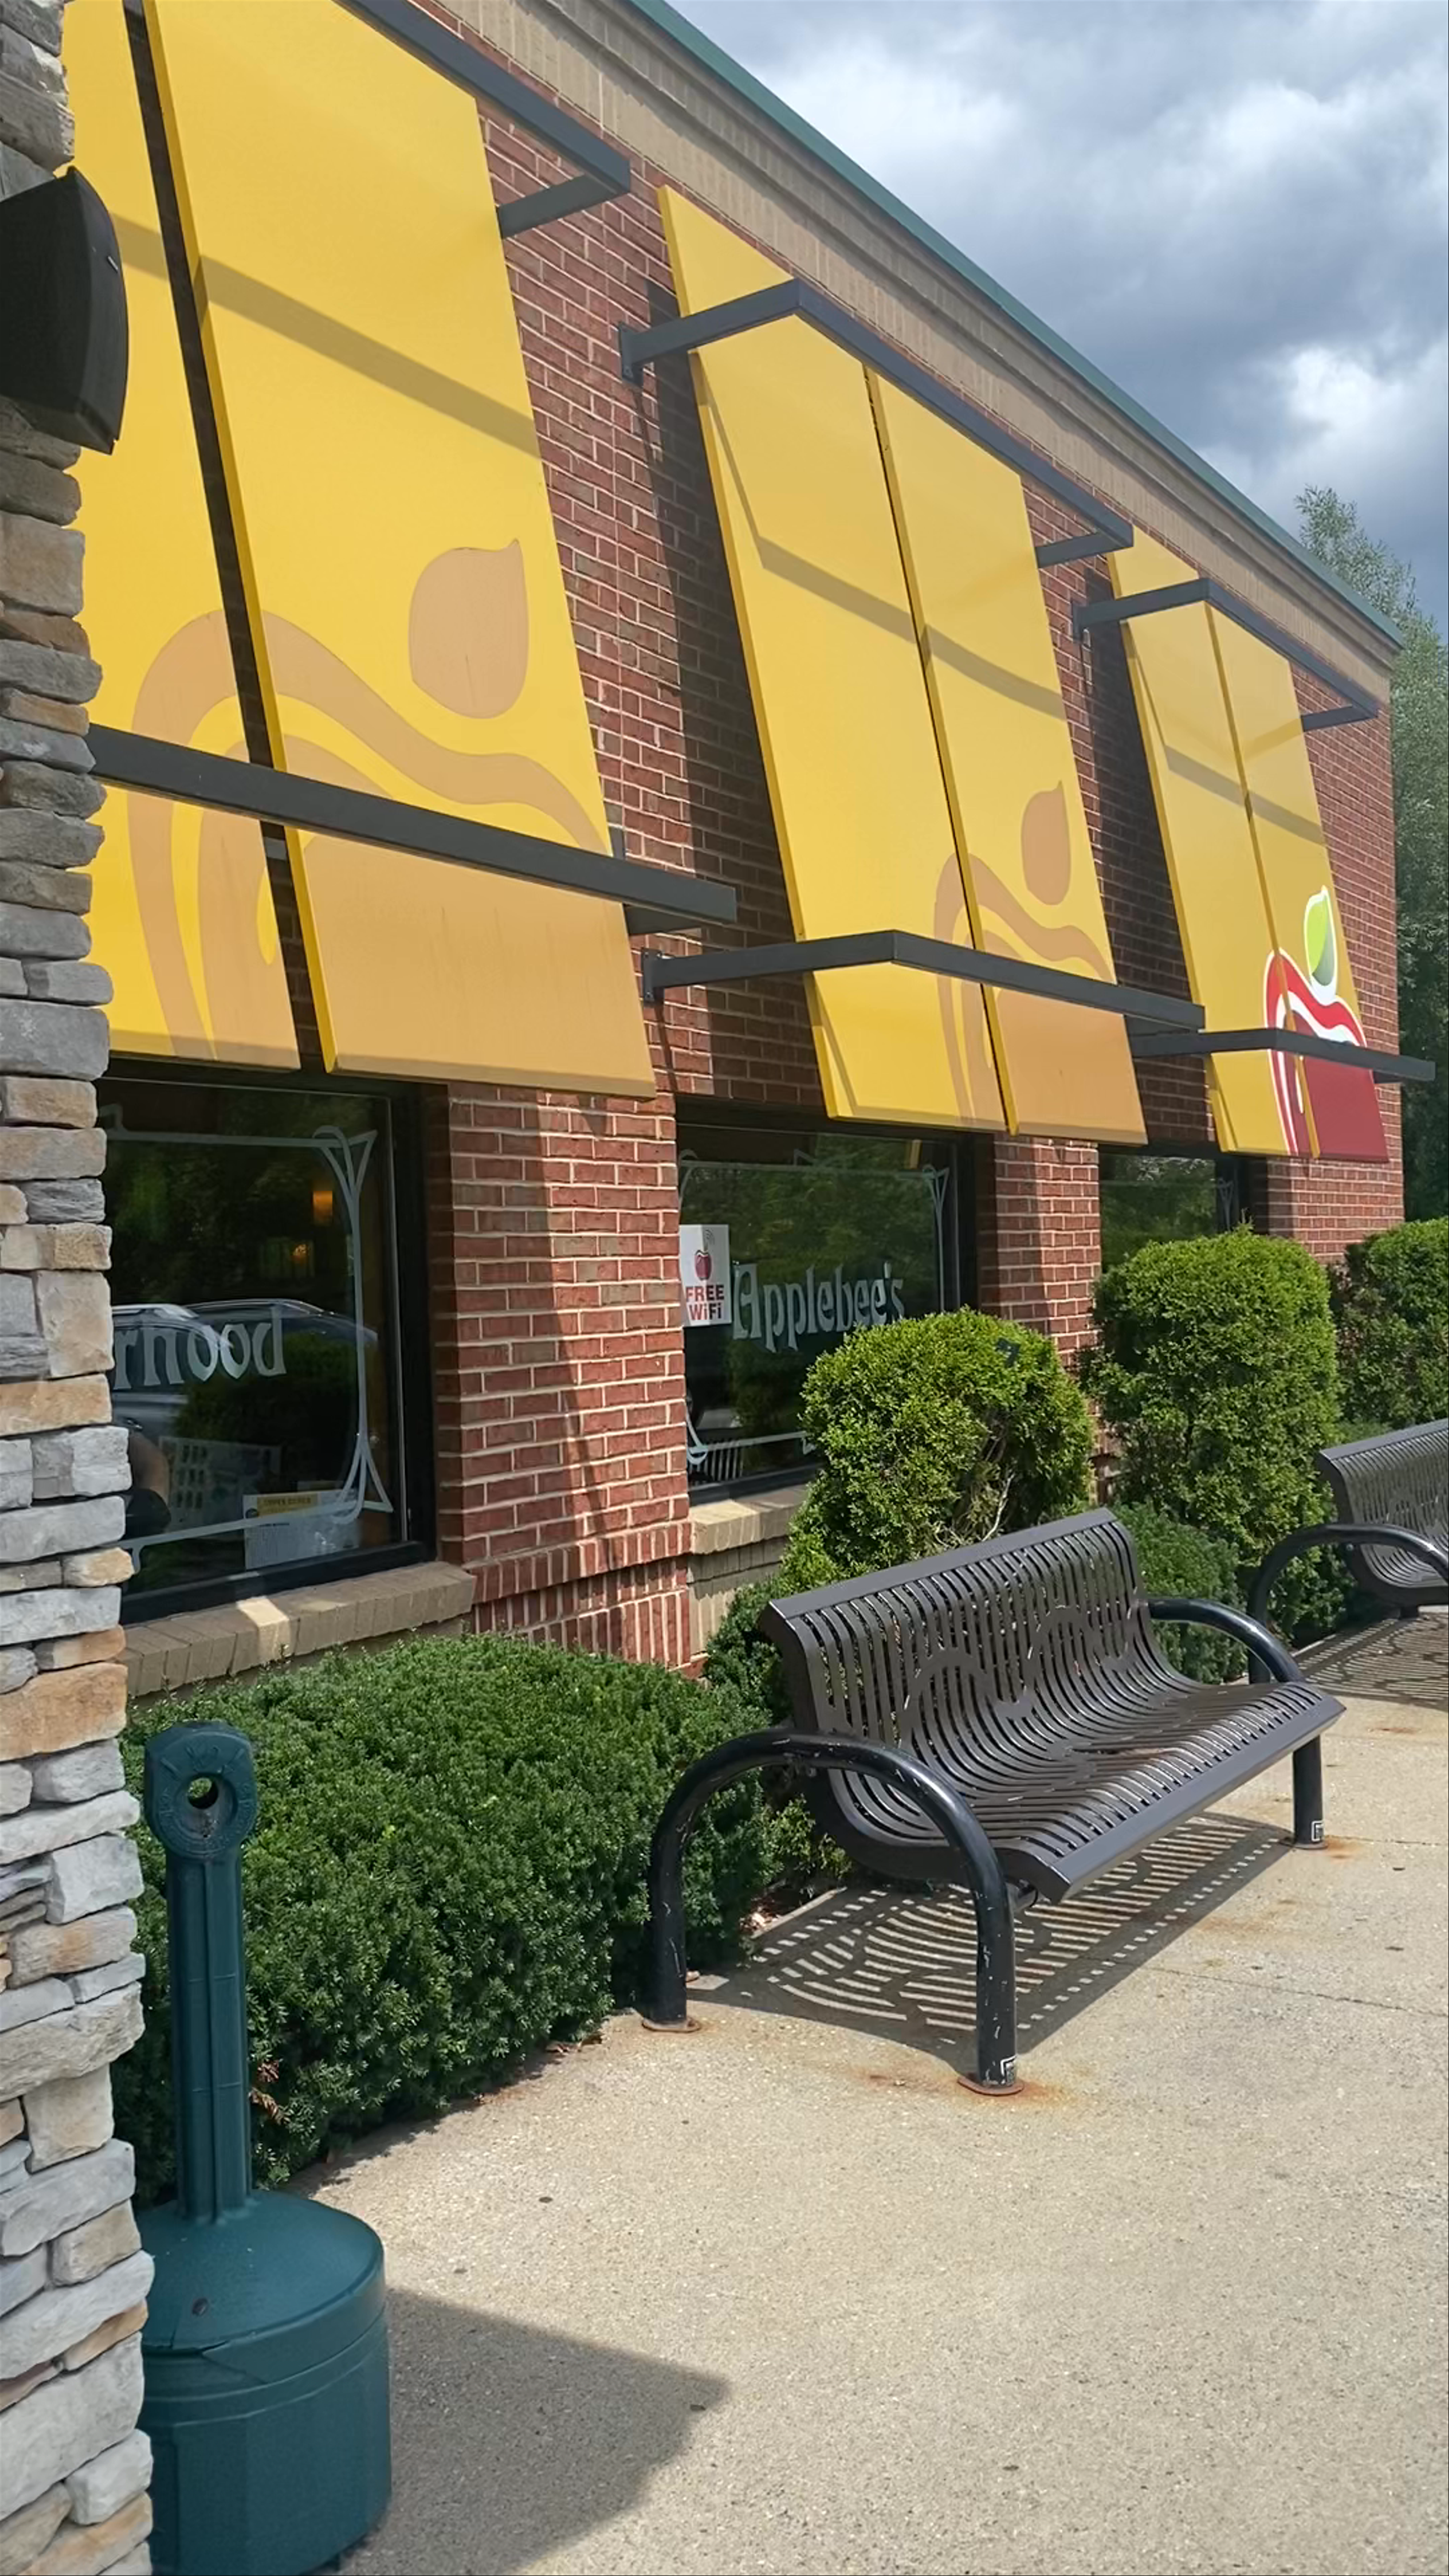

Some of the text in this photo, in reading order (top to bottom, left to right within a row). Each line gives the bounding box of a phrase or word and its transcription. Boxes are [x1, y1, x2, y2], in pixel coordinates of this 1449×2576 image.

[686, 1284, 724, 1302] FREE
[689, 1303, 721, 1320] WiFi
[733, 1261, 904, 1353] Applebee's
